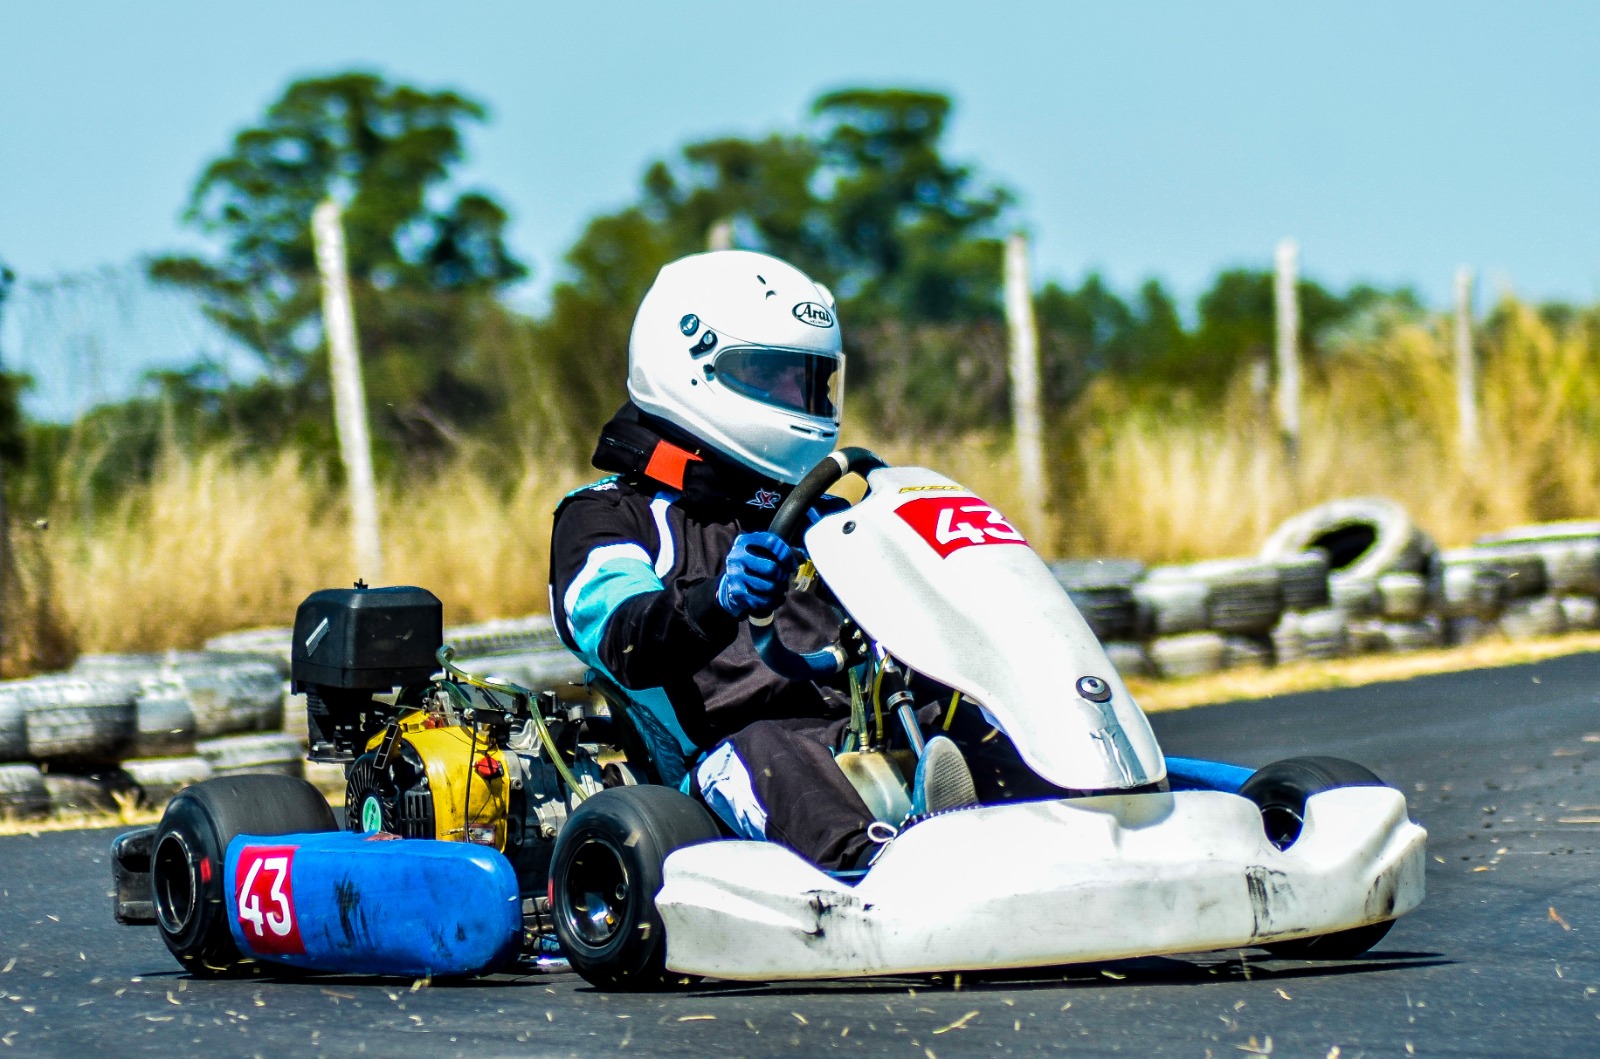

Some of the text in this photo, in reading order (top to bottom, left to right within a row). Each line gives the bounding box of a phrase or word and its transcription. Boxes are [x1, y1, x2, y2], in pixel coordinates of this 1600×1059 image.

[797, 304, 831, 322] Arai
[935, 505, 1027, 545] 43
[239, 857, 292, 937] 43
